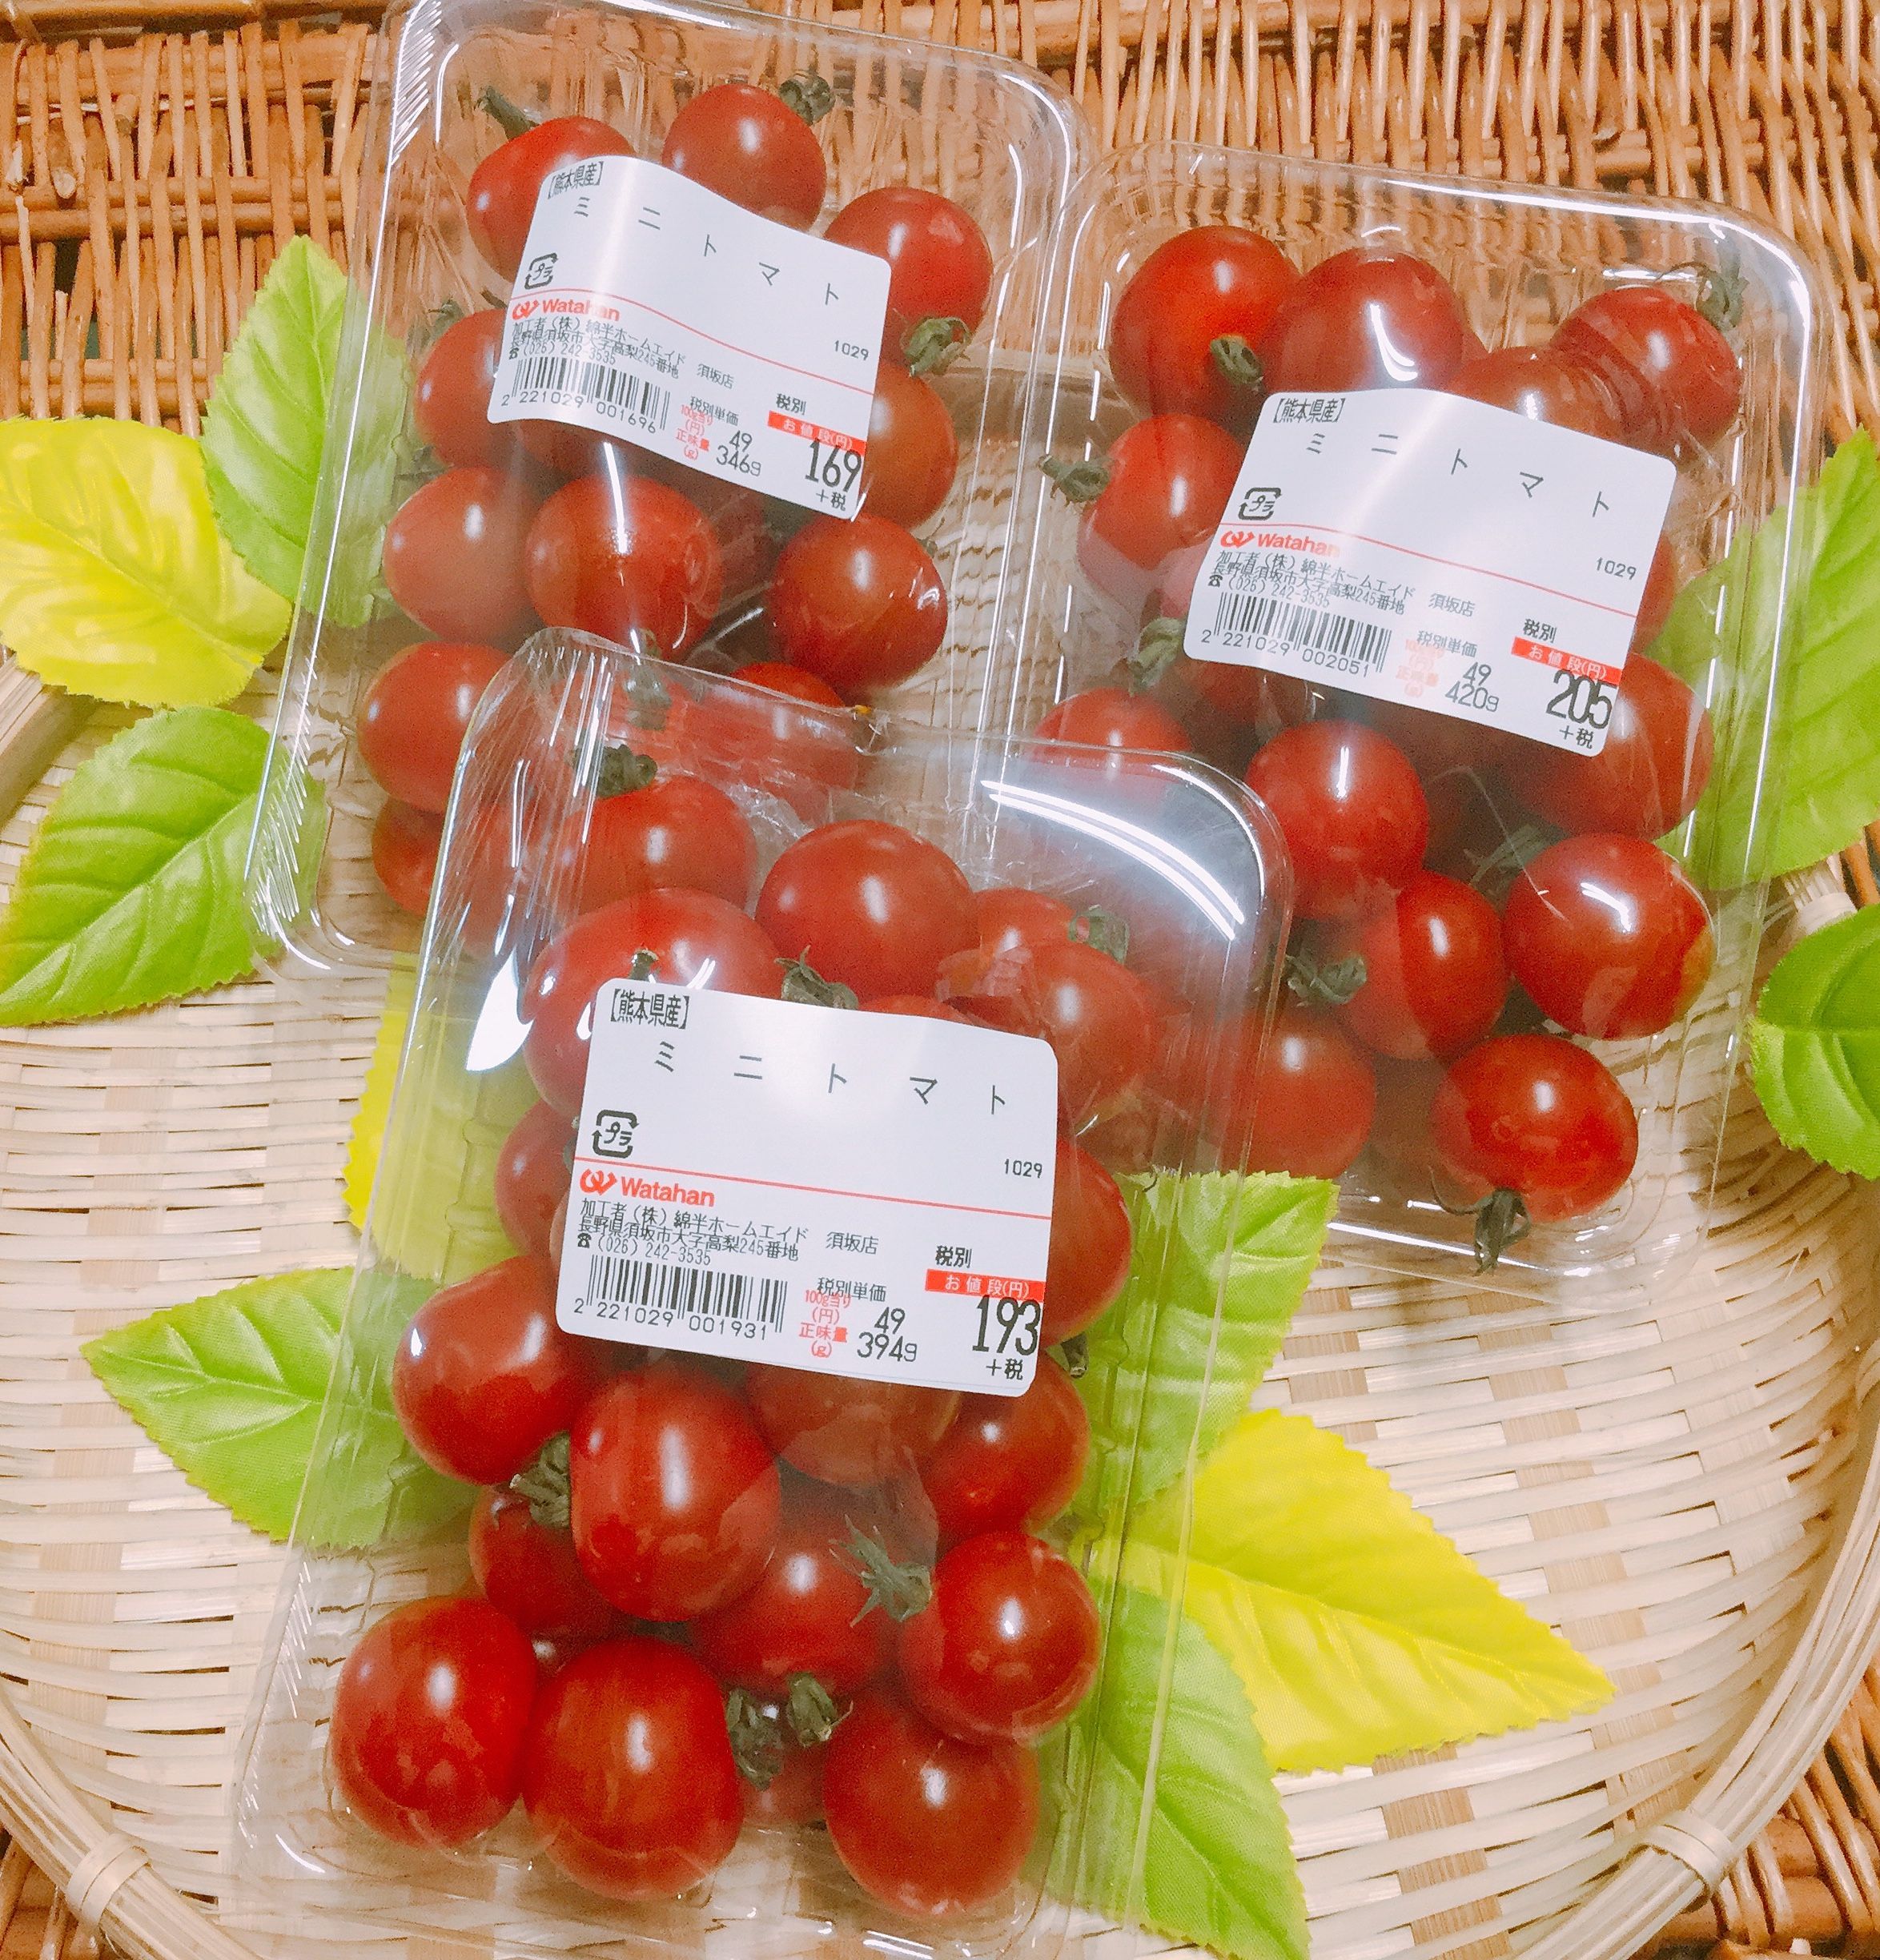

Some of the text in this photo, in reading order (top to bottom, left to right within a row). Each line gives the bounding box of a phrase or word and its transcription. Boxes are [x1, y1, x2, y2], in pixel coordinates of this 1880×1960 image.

[834, 340, 870, 360] 1029
[697, 363, 735, 389] 須坂店
[500, 391, 657, 434] 2 221029 001696
[690, 396, 739, 426] 税別単価
[776, 393, 806, 416] 税別
[1272, 398, 1346, 424] 【熊本県産】
[729, 430, 753, 452] 49
[805, 437, 862, 492] 169
[1257, 533, 1341, 557] Watahan
[1596, 557, 1637, 580] 1029
[1428, 592, 1476, 617] 須坂店
[1416, 629, 1477, 658] 税別単価
[1523, 618, 1557, 644] 税別
[1201, 629, 1212, 644] 2
[1223, 632, 1290, 656] 221029
[1301, 649, 1368, 678] 002051
[1463, 661, 1492, 687] 49
[1546, 669, 1618, 730] 205
[610, 988, 689, 1030] 【熊本県産】
[1004, 1159, 1042, 1179] 1029
[621, 1176, 715, 1207] Watahan
[826, 1231, 878, 1255] 須坂店
[934, 1245, 973, 1268] 税別
[817, 1276, 887, 1302] 税別単価
[574, 1298, 765, 1340] 2 221029 001931
[874, 1306, 906, 1335] 49
[972, 1294, 1042, 1356] 193
[857, 1331, 918, 1363] 394g
